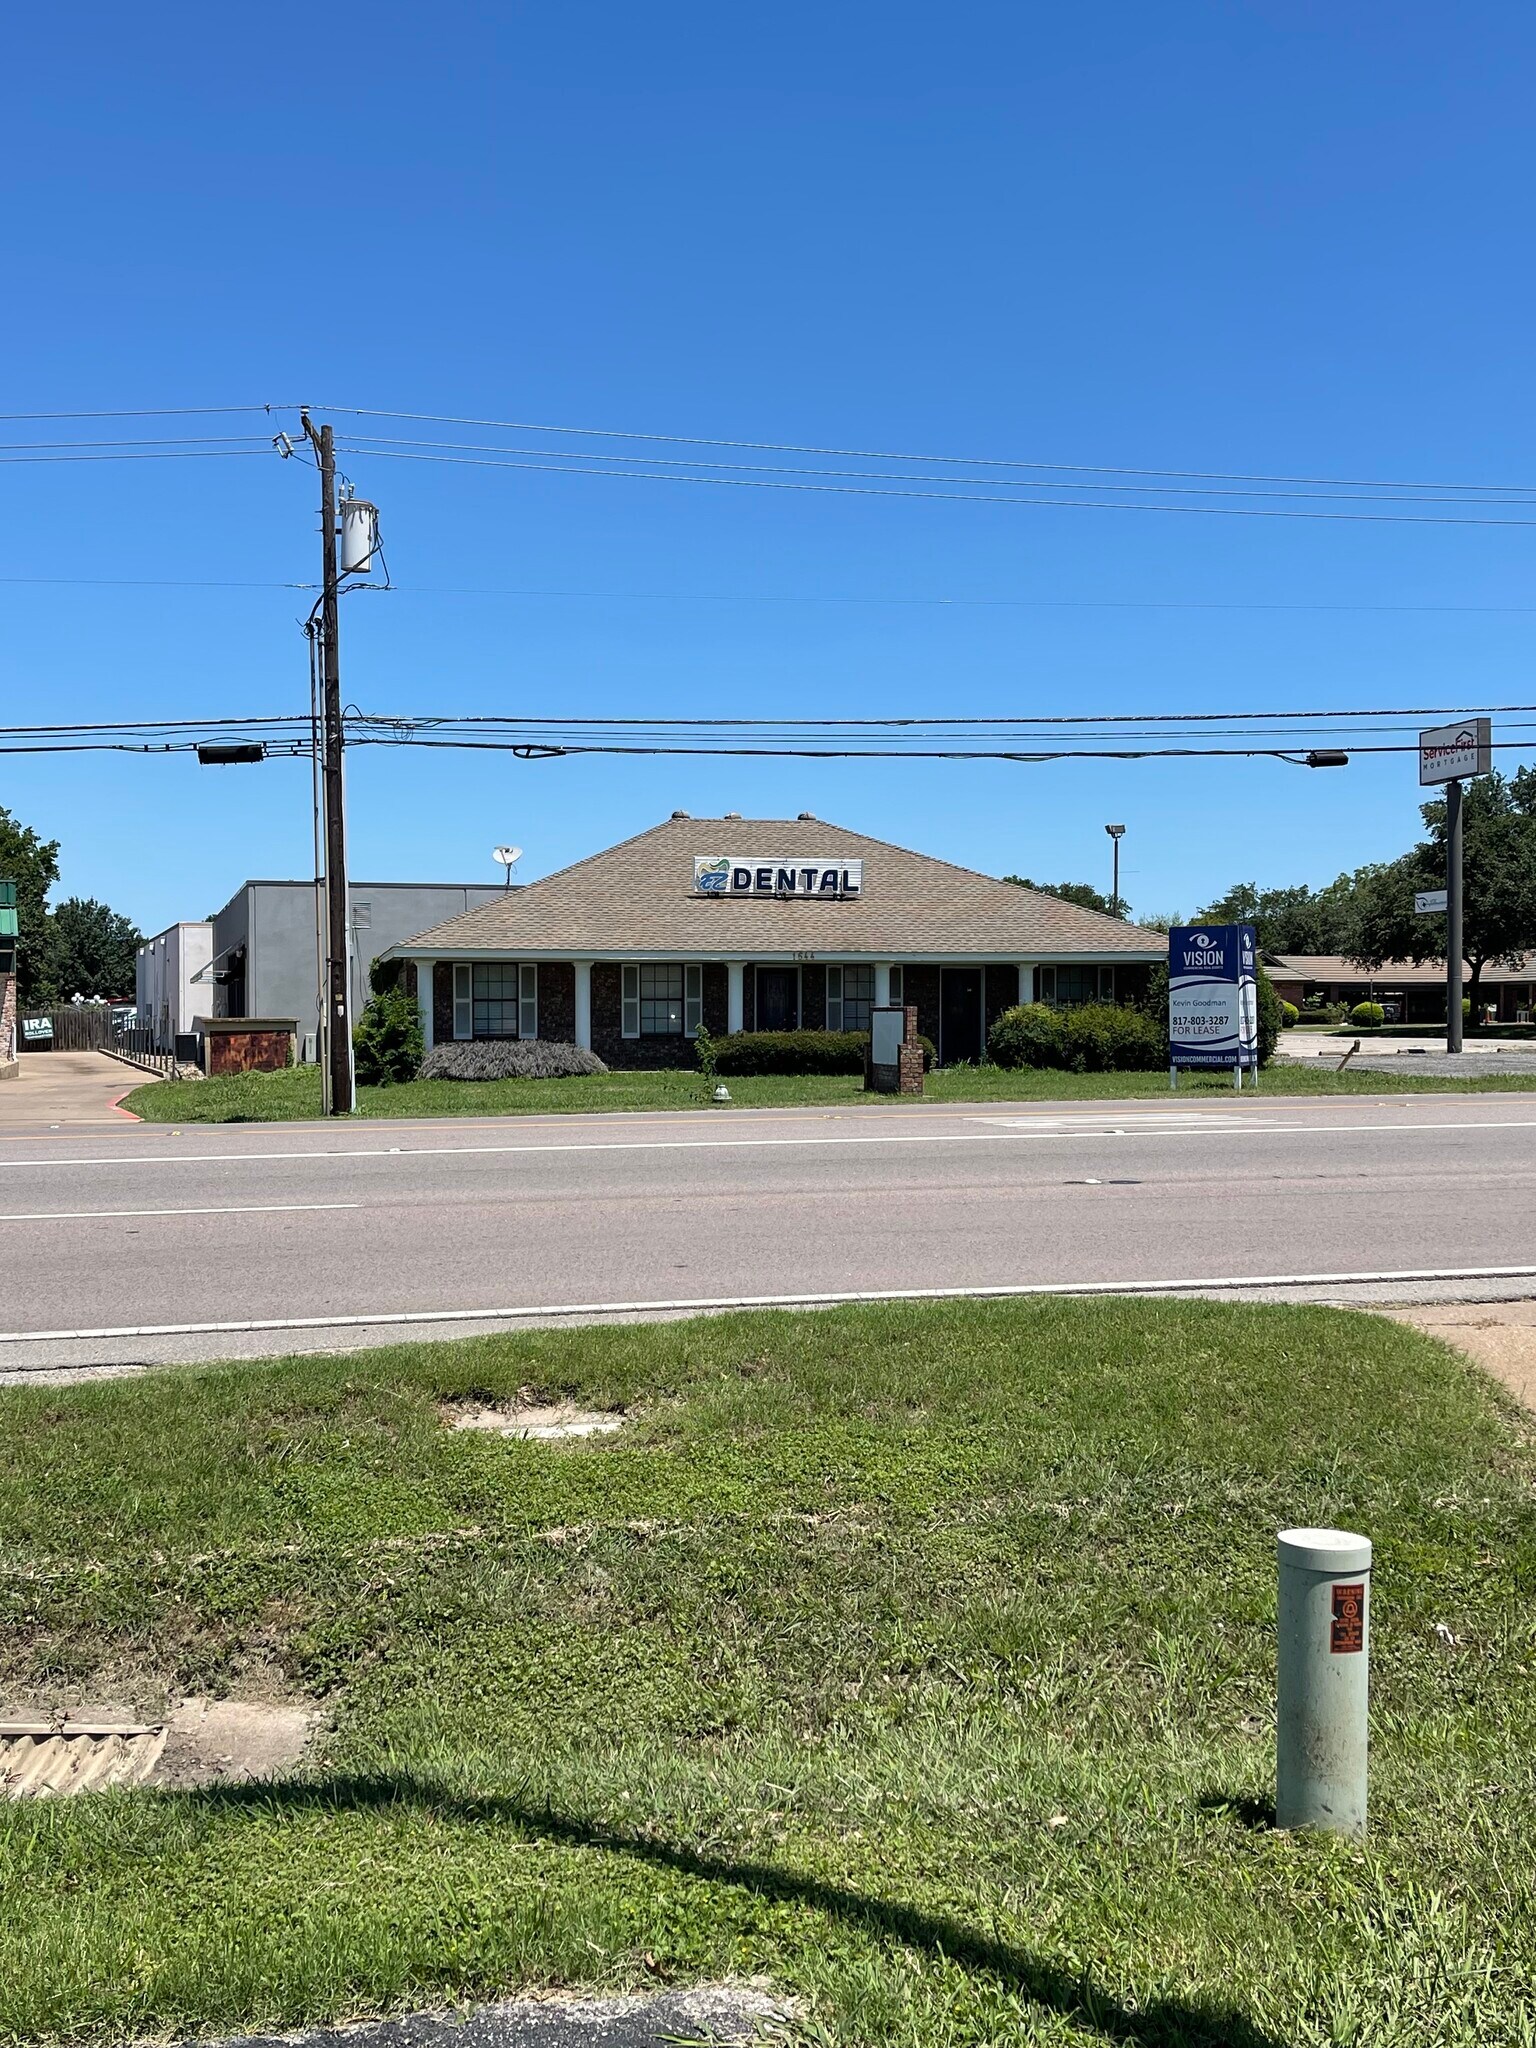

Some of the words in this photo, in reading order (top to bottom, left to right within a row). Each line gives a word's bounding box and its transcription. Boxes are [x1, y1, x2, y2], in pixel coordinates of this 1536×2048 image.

[1423, 752, 1475, 770] MORTGAGE
[733, 867, 859, 892] DENTAL
[1183, 950, 1224, 966] VISION
[23, 1017, 52, 1031] IRA
[1172, 1016, 1229, 1026] 817-803-3287
[1172, 1026, 1191, 1035] FOR
[1193, 1026, 1220, 1035] LEASE
[1172, 1055, 1237, 1063] VISIONCOMMERCIAL.COM
